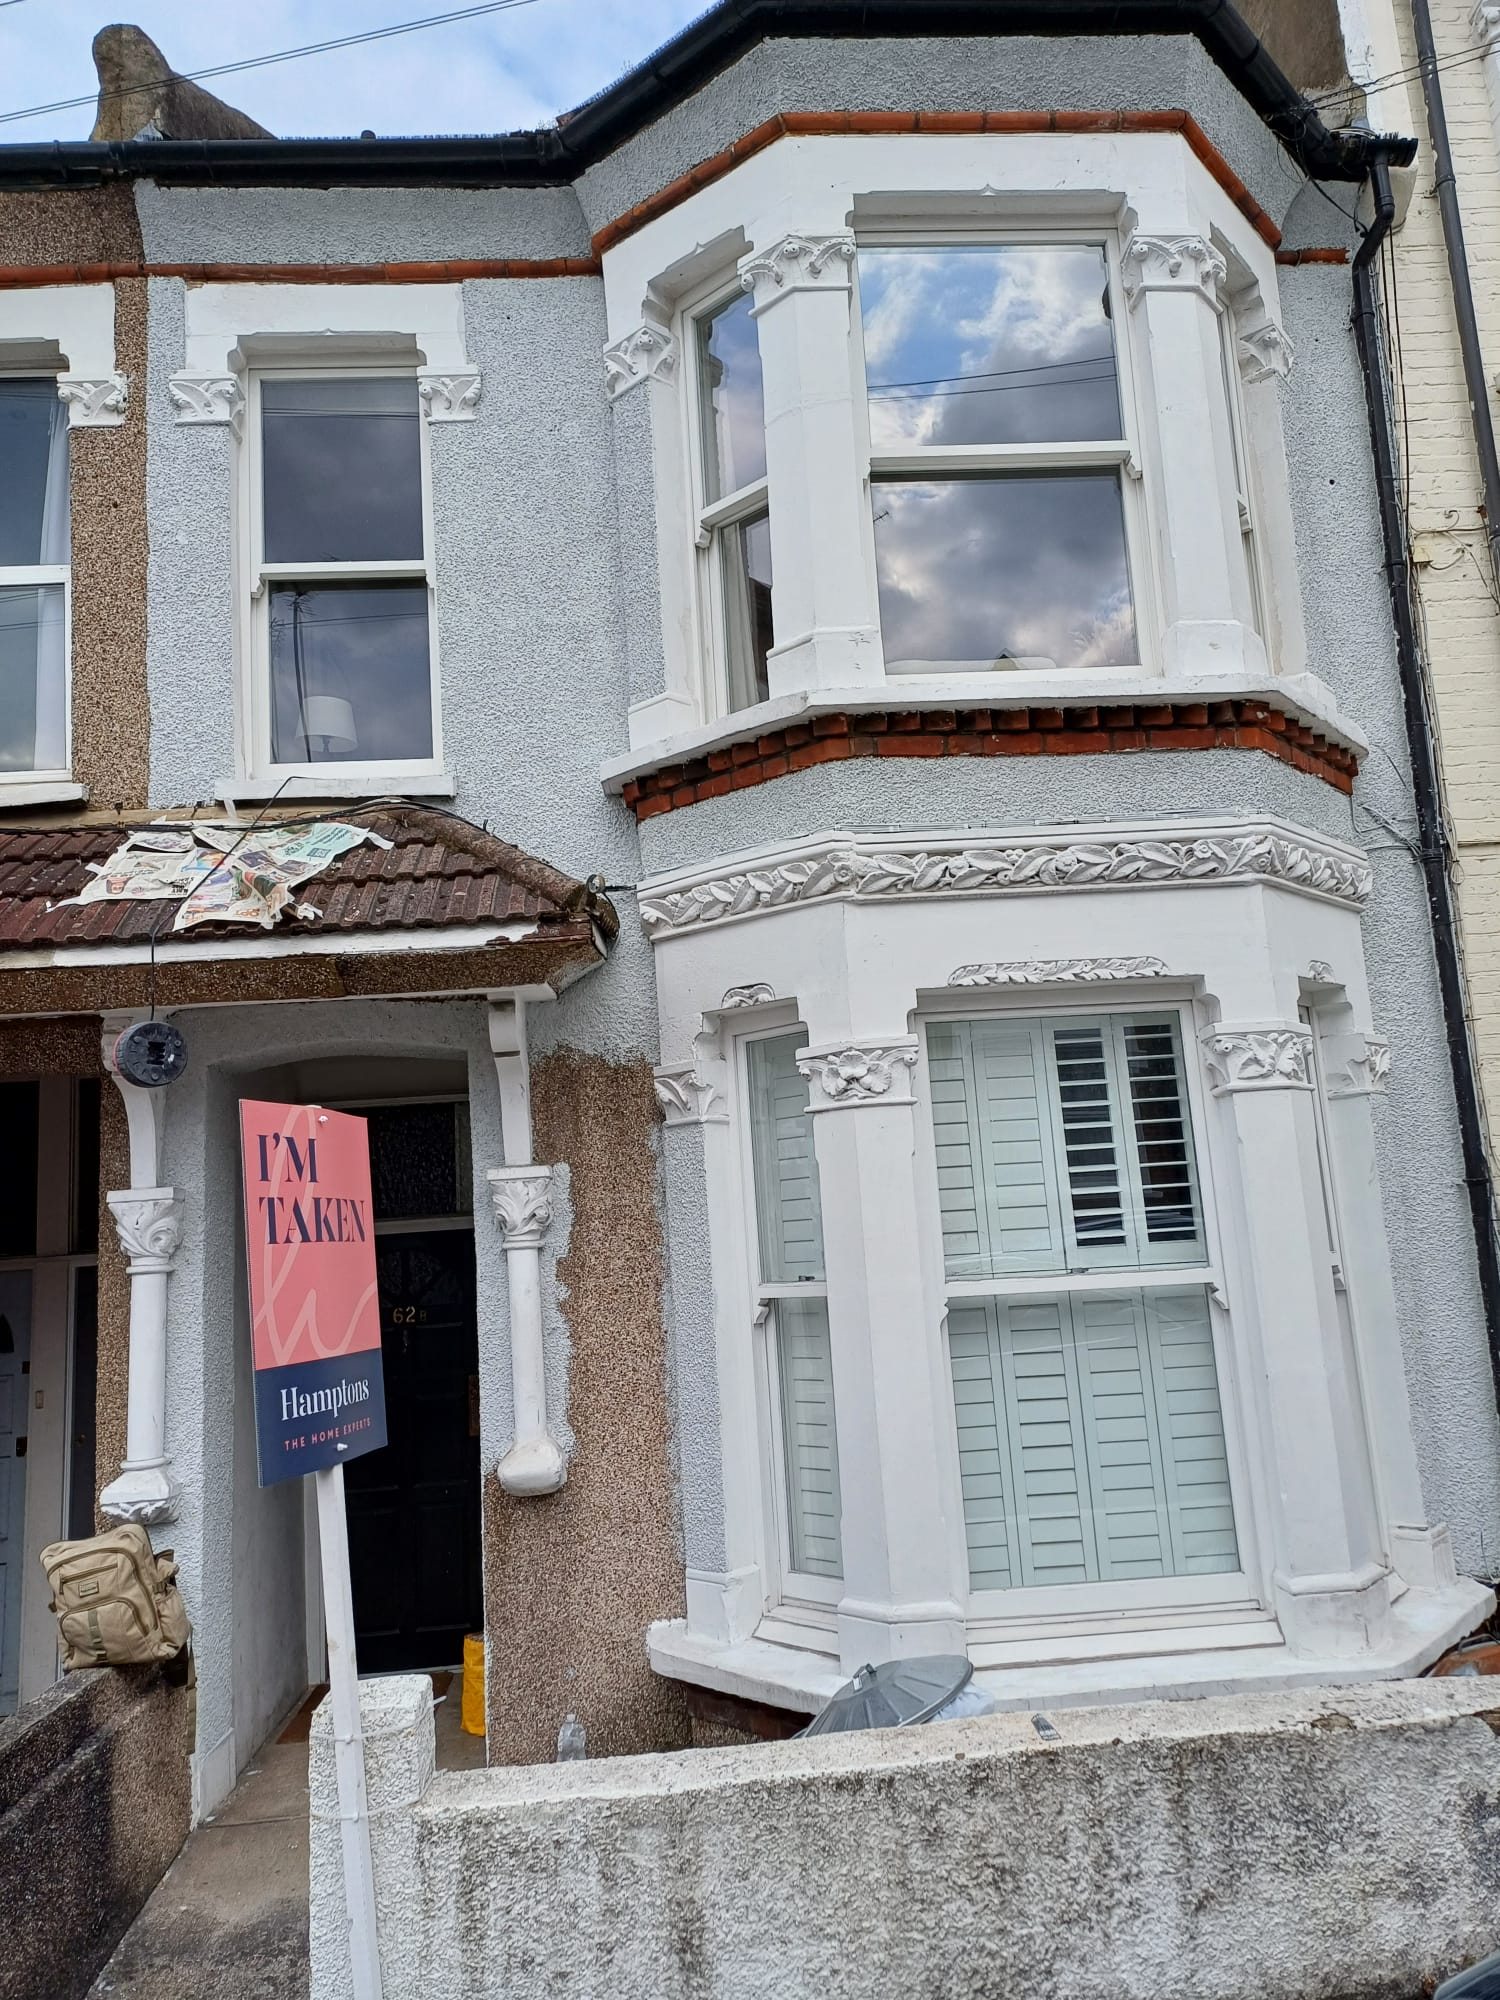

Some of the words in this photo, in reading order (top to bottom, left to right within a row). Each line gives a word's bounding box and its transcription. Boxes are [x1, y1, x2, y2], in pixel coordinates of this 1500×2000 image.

[257, 1132, 319, 1184] I'M
[258, 1196, 366, 1245] TAKEN
[280, 1378, 370, 1421] Hamptons
[284, 1436, 306, 1452] THE
[311, 1427, 340, 1444] HOME
[342, 1417, 371, 1436] EXPERTS
